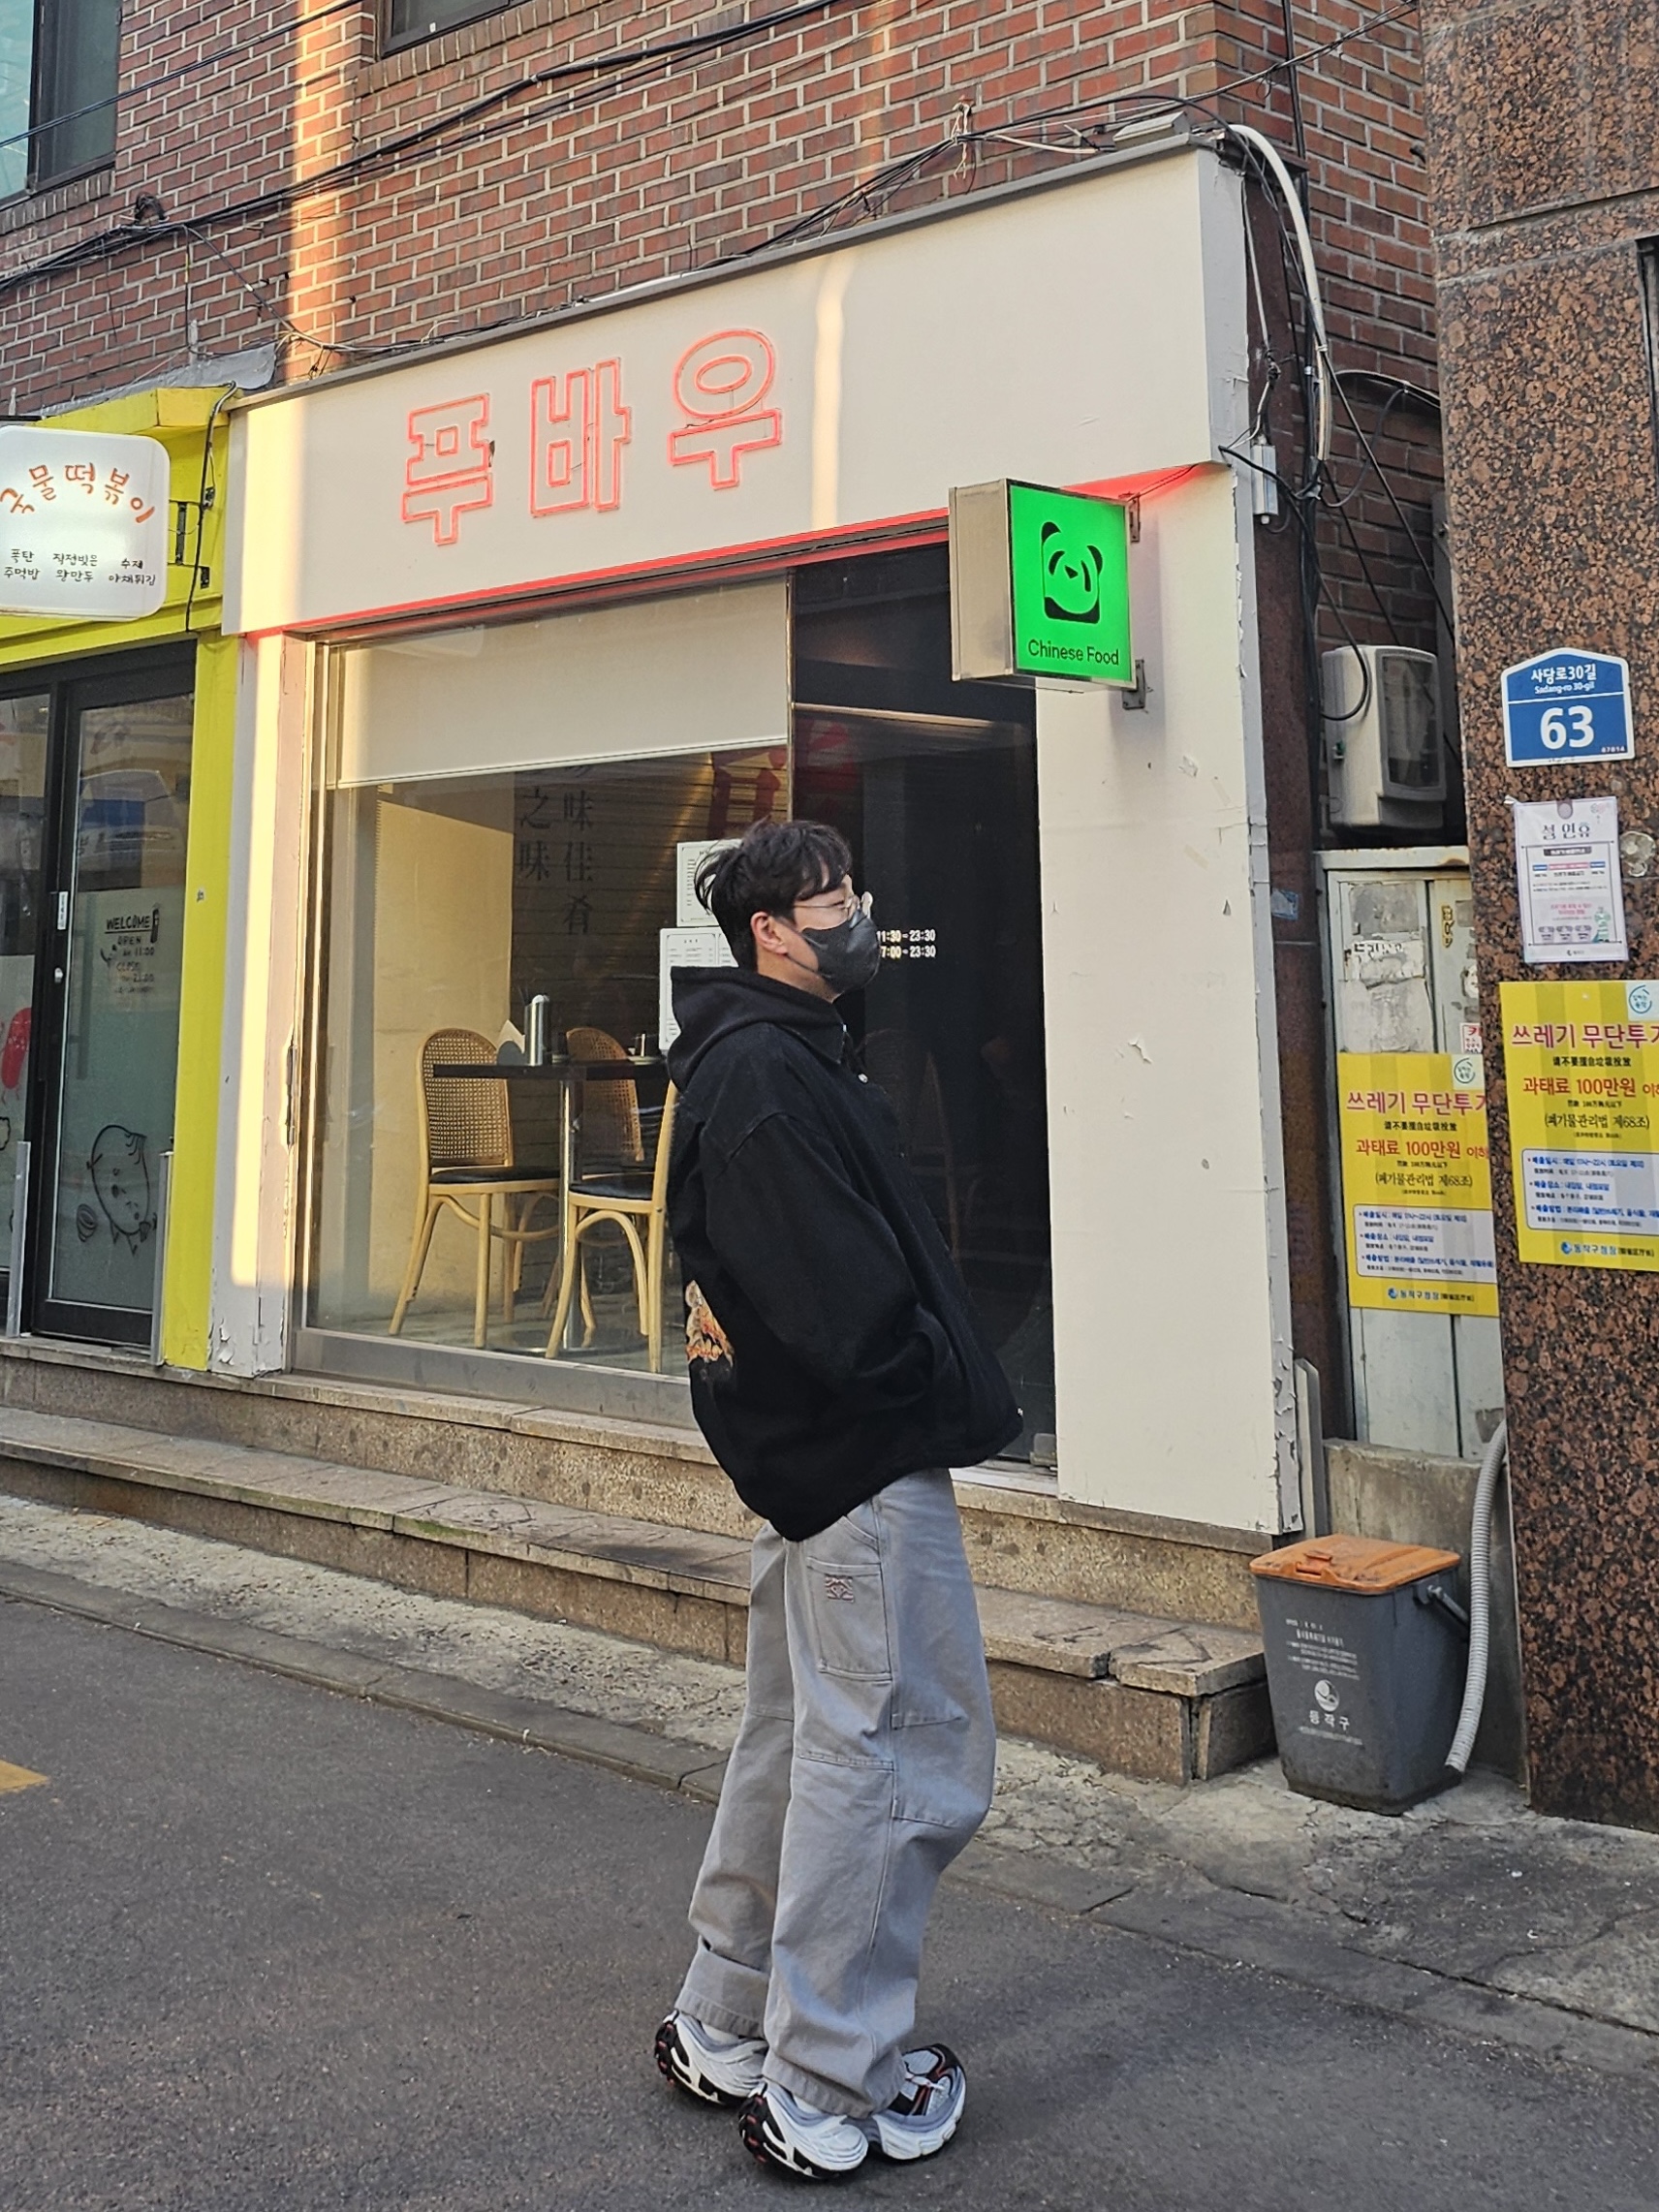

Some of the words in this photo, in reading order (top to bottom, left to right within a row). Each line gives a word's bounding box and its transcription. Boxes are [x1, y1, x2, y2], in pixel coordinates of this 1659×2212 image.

[400, 328, 783, 545] 푸바우
[4, 567, 41, 580] 주먹밥
[56, 569, 93, 582] 왕만두
[1028, 639, 1083, 662] Chinese
[1087, 646, 1119, 666] Food
[1530, 663, 1597, 684] 사당로30길
[1534, 684, 1573, 694] Sadang-ro
[1573, 681, 1595, 691] 30-gil
[1540, 704, 1594, 750] 63
[107, 915, 150, 930] WELCOME
[1512, 1024, 1576, 1048] 쓰레기
[1523, 1076, 1571, 1096] 과태료
[1576, 1076, 1637, 1098] 100만원
[1347, 1091, 1406, 1114] 쓰레기
[1356, 1138, 1400, 1157] 과태료
[1406, 1140, 1461, 1160] 100만원
[1308, 1709, 1351, 1732] 동작구
